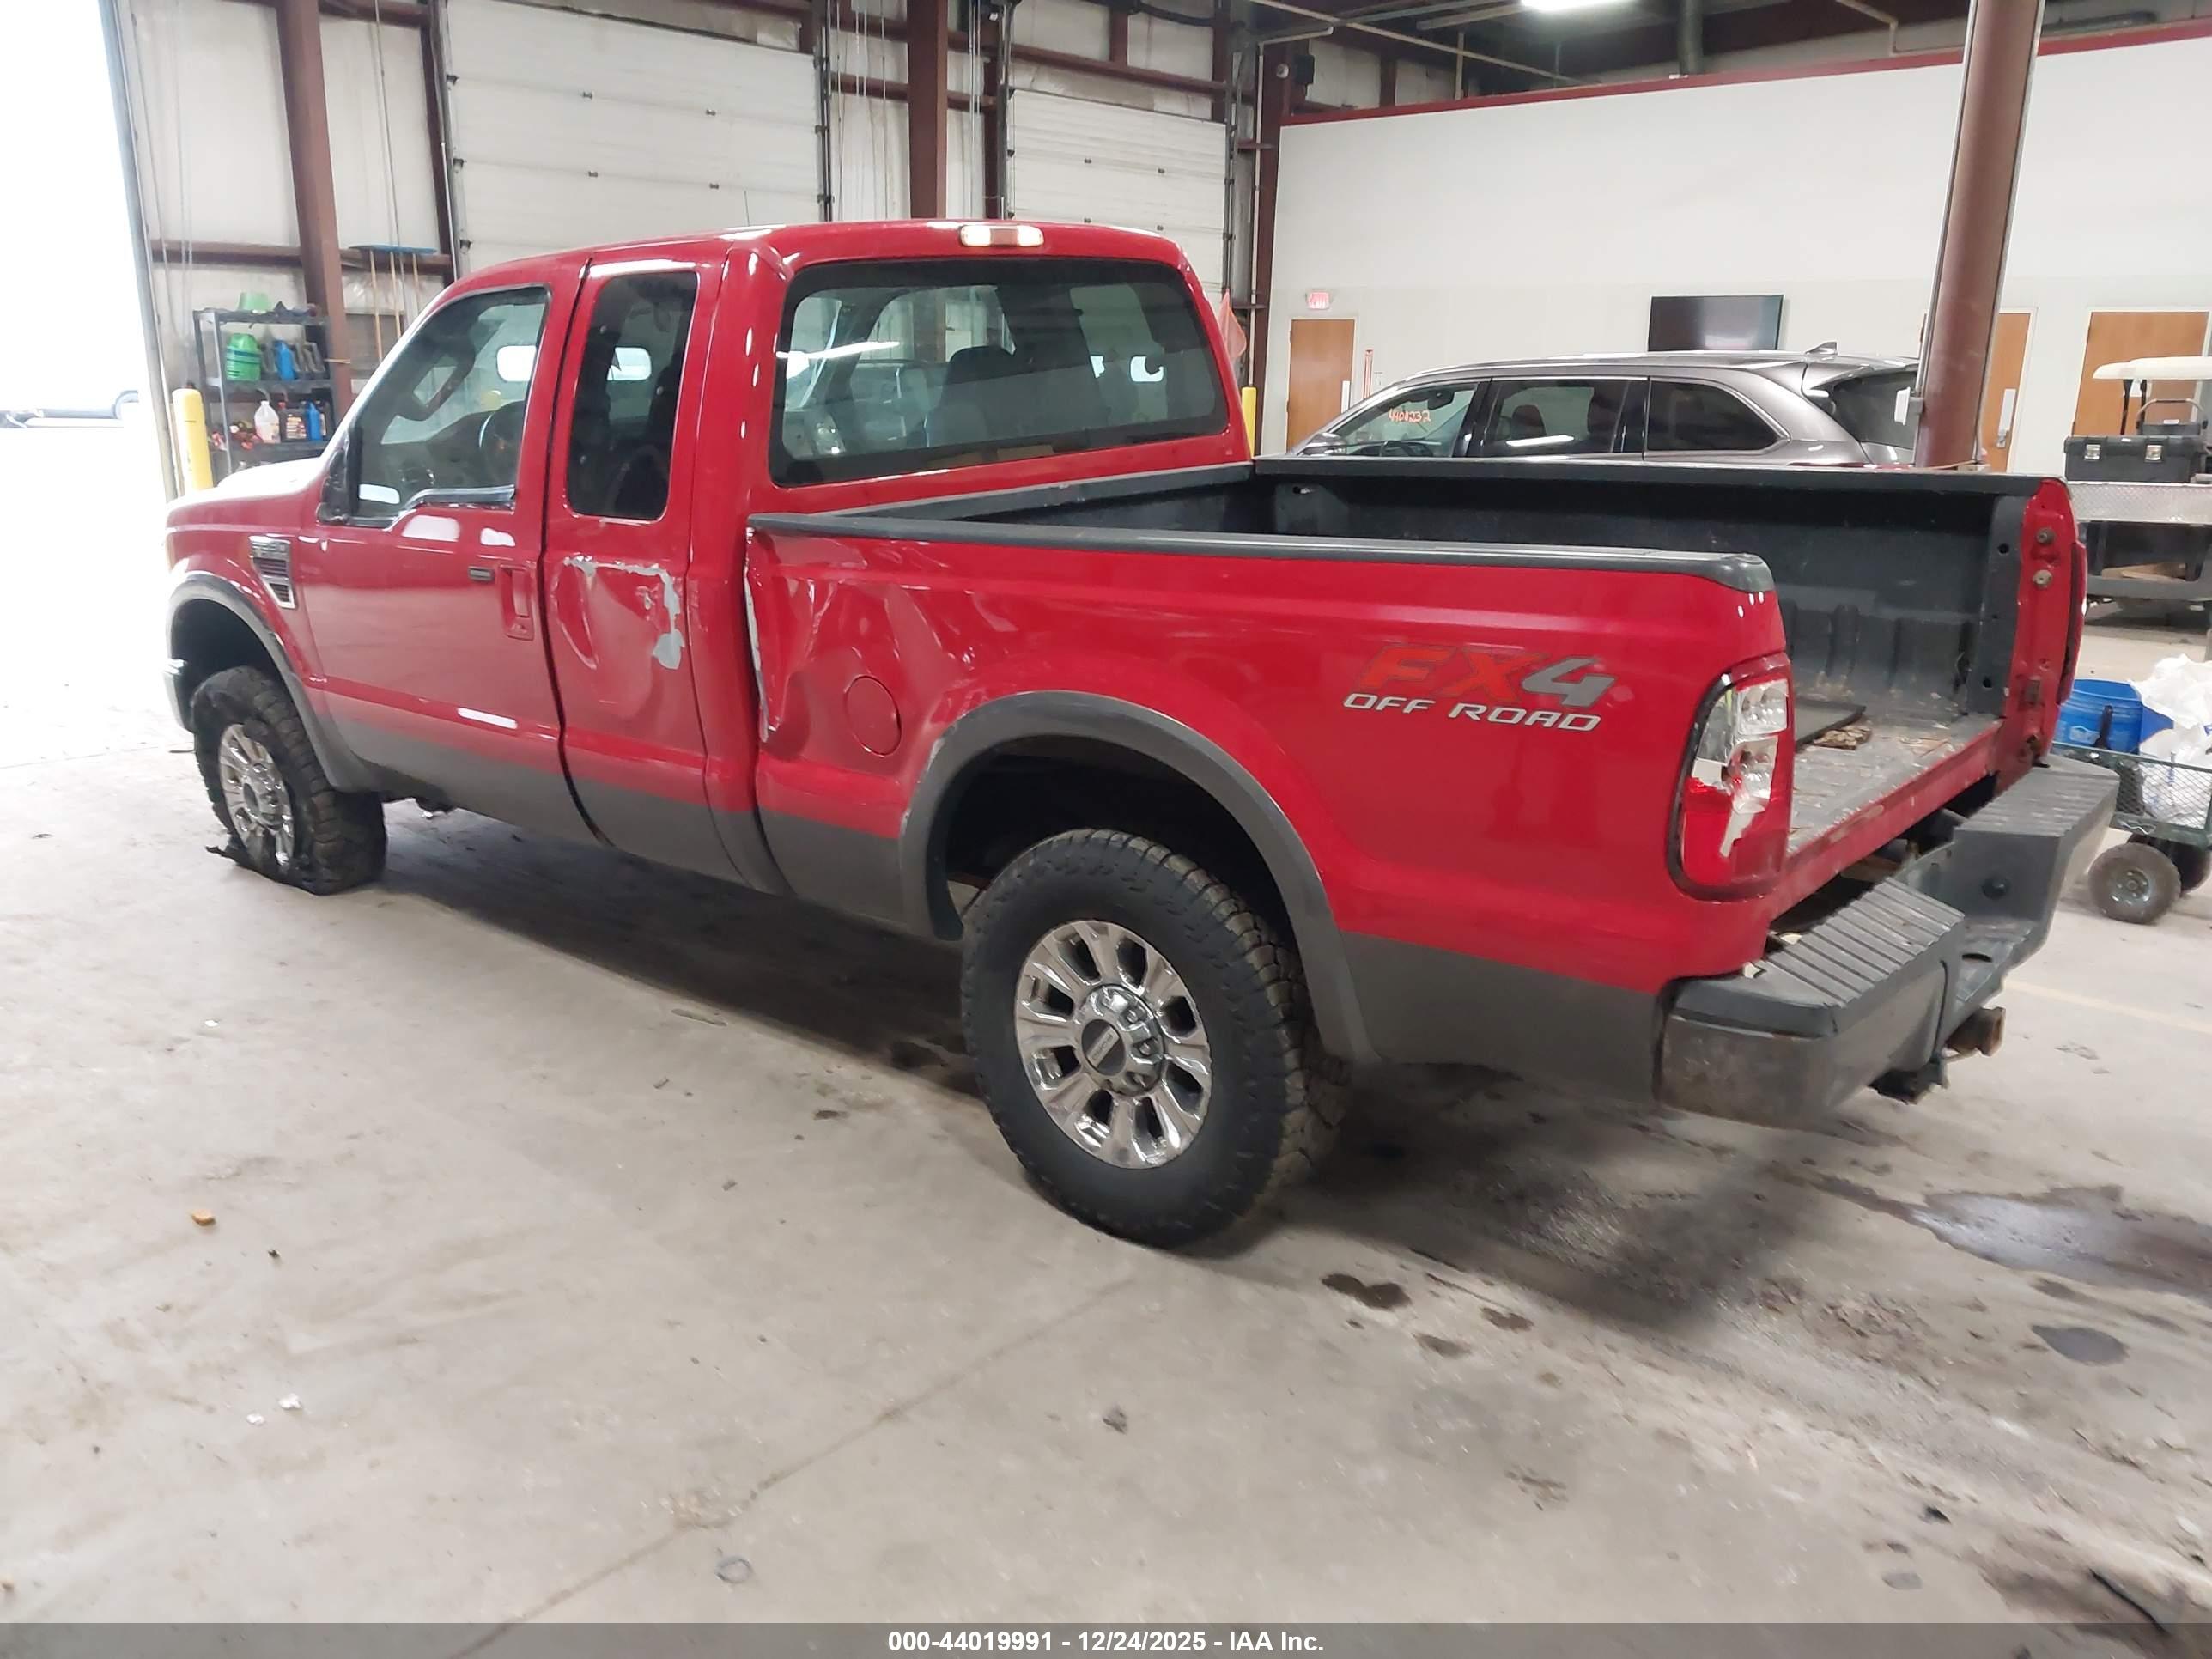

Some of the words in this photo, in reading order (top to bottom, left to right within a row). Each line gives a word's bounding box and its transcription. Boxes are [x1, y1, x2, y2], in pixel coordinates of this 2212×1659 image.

[1351, 645, 1616, 708] FX4
[1343, 693, 1436, 714] OFF
[1448, 702, 1601, 732] ROAD
